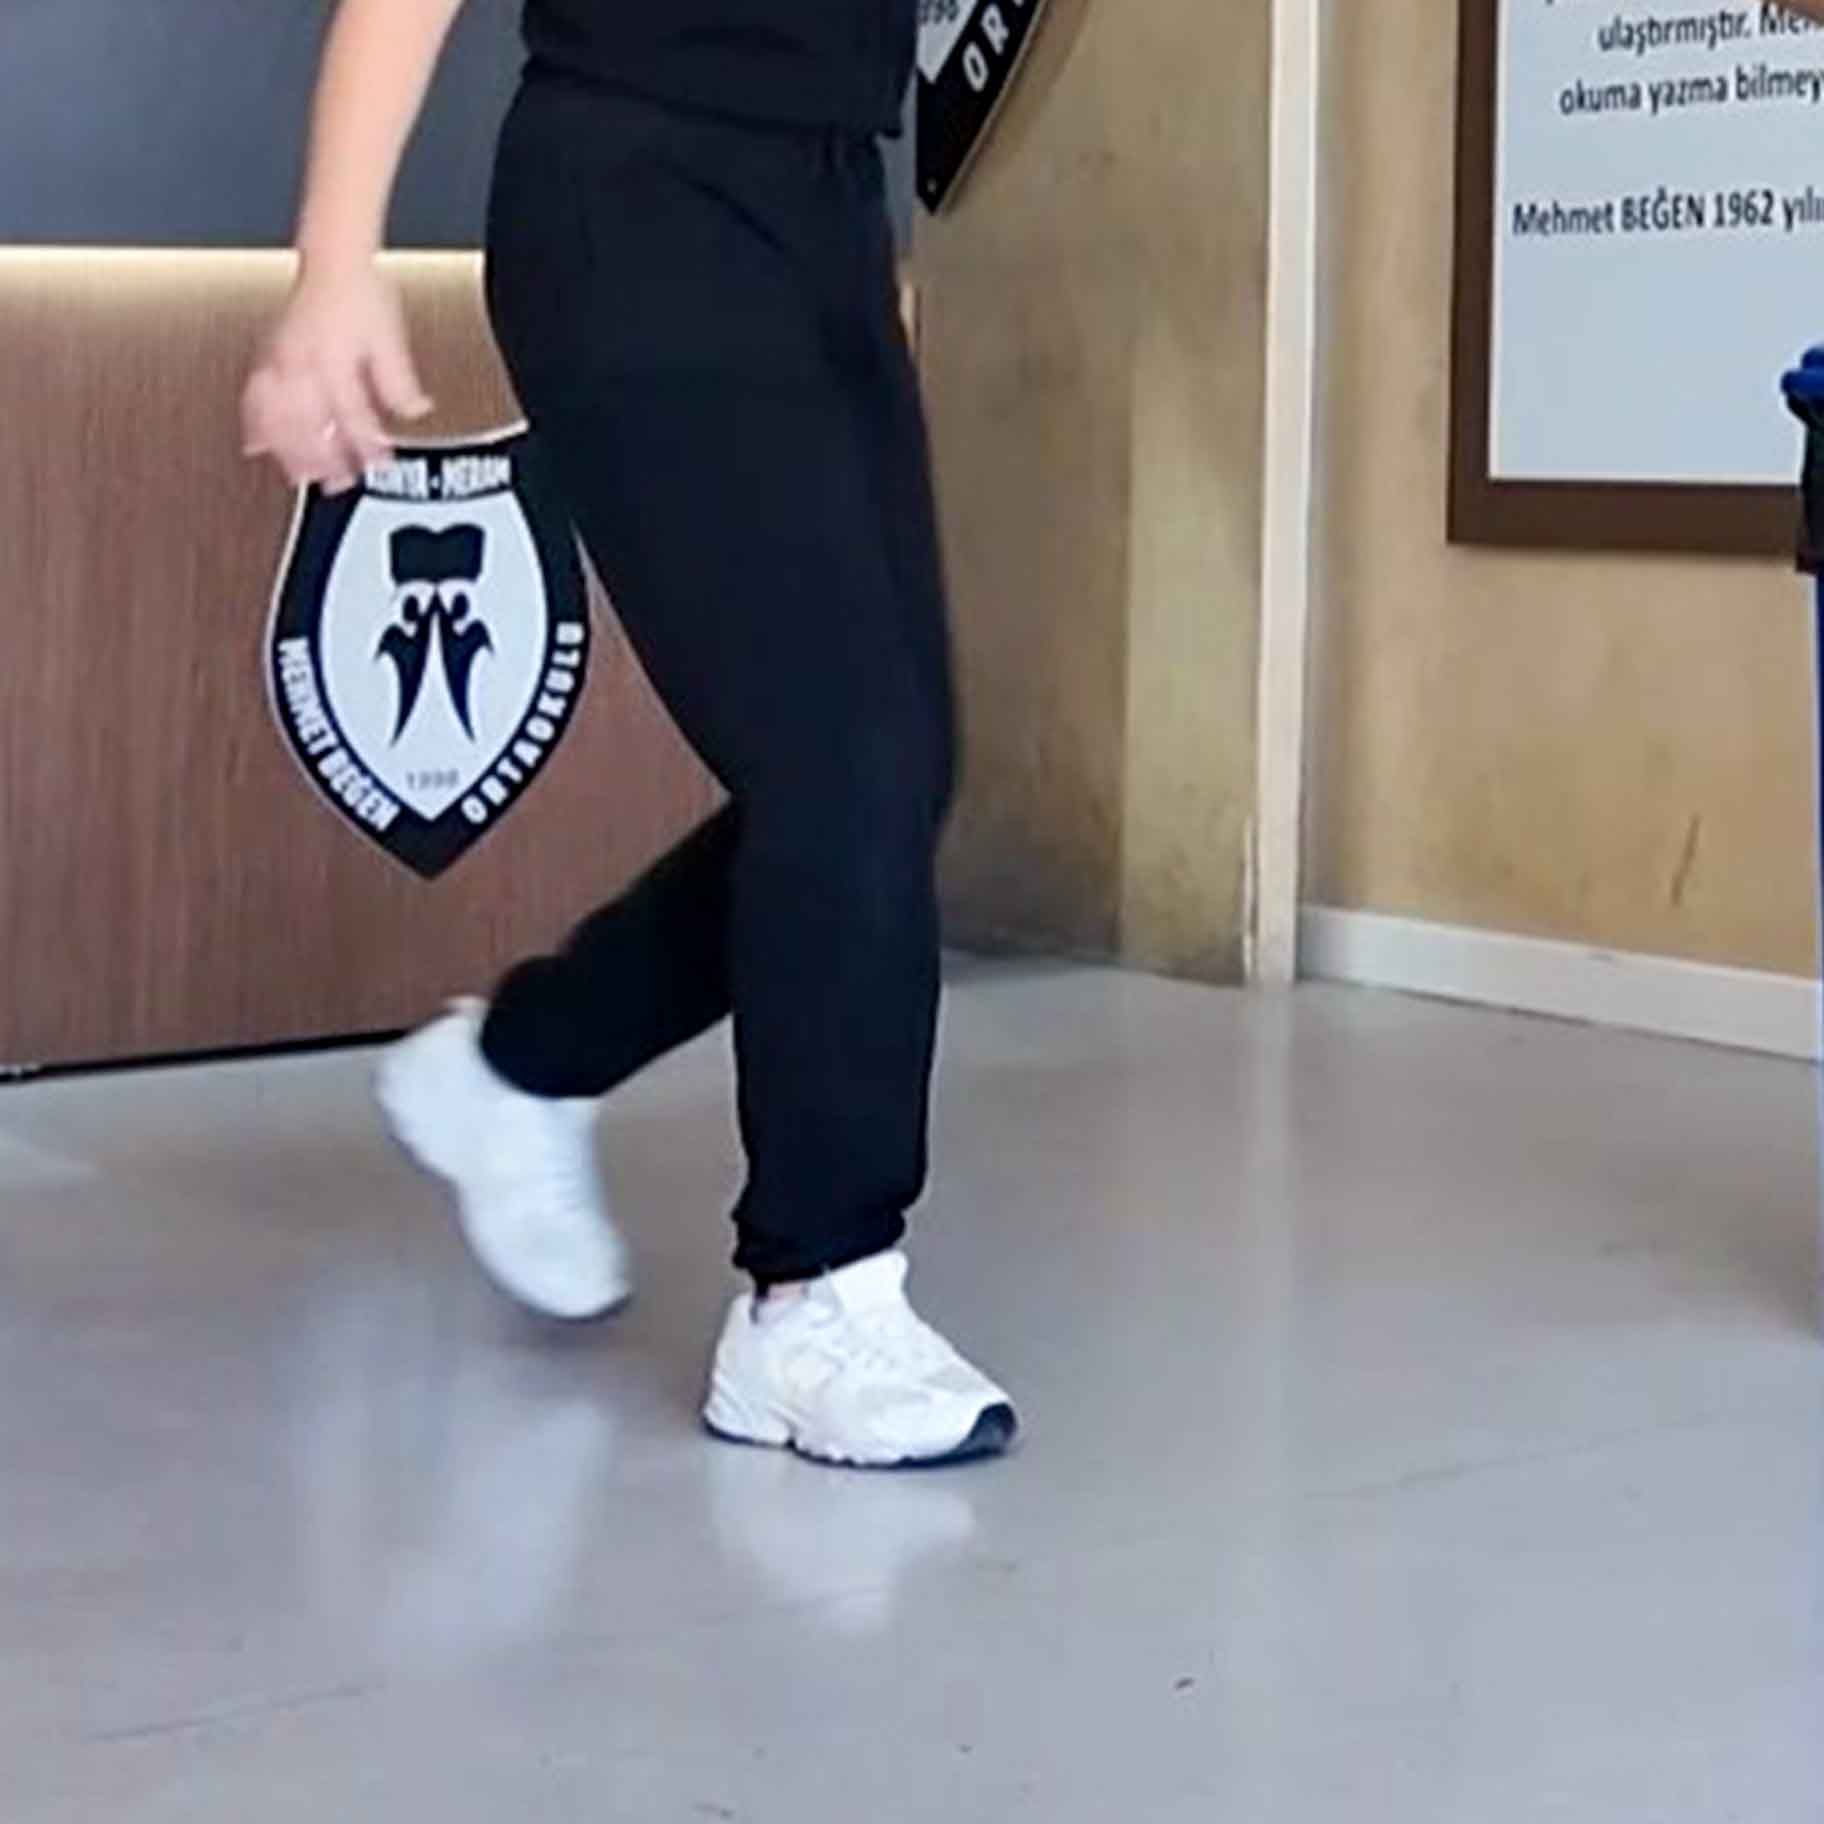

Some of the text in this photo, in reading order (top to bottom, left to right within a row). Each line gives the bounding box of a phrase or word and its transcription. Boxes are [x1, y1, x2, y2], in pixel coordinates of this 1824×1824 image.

[1597, 8, 1751, 55] ulaştırmıştır.
[1559, 78, 1642, 115] okuma
[1649, 74, 1729, 116] yazma
[1511, 200, 1614, 237] Mehmet
[1620, 186, 1706, 232] BEĞEN
[1712, 188, 1774, 229] 1962
